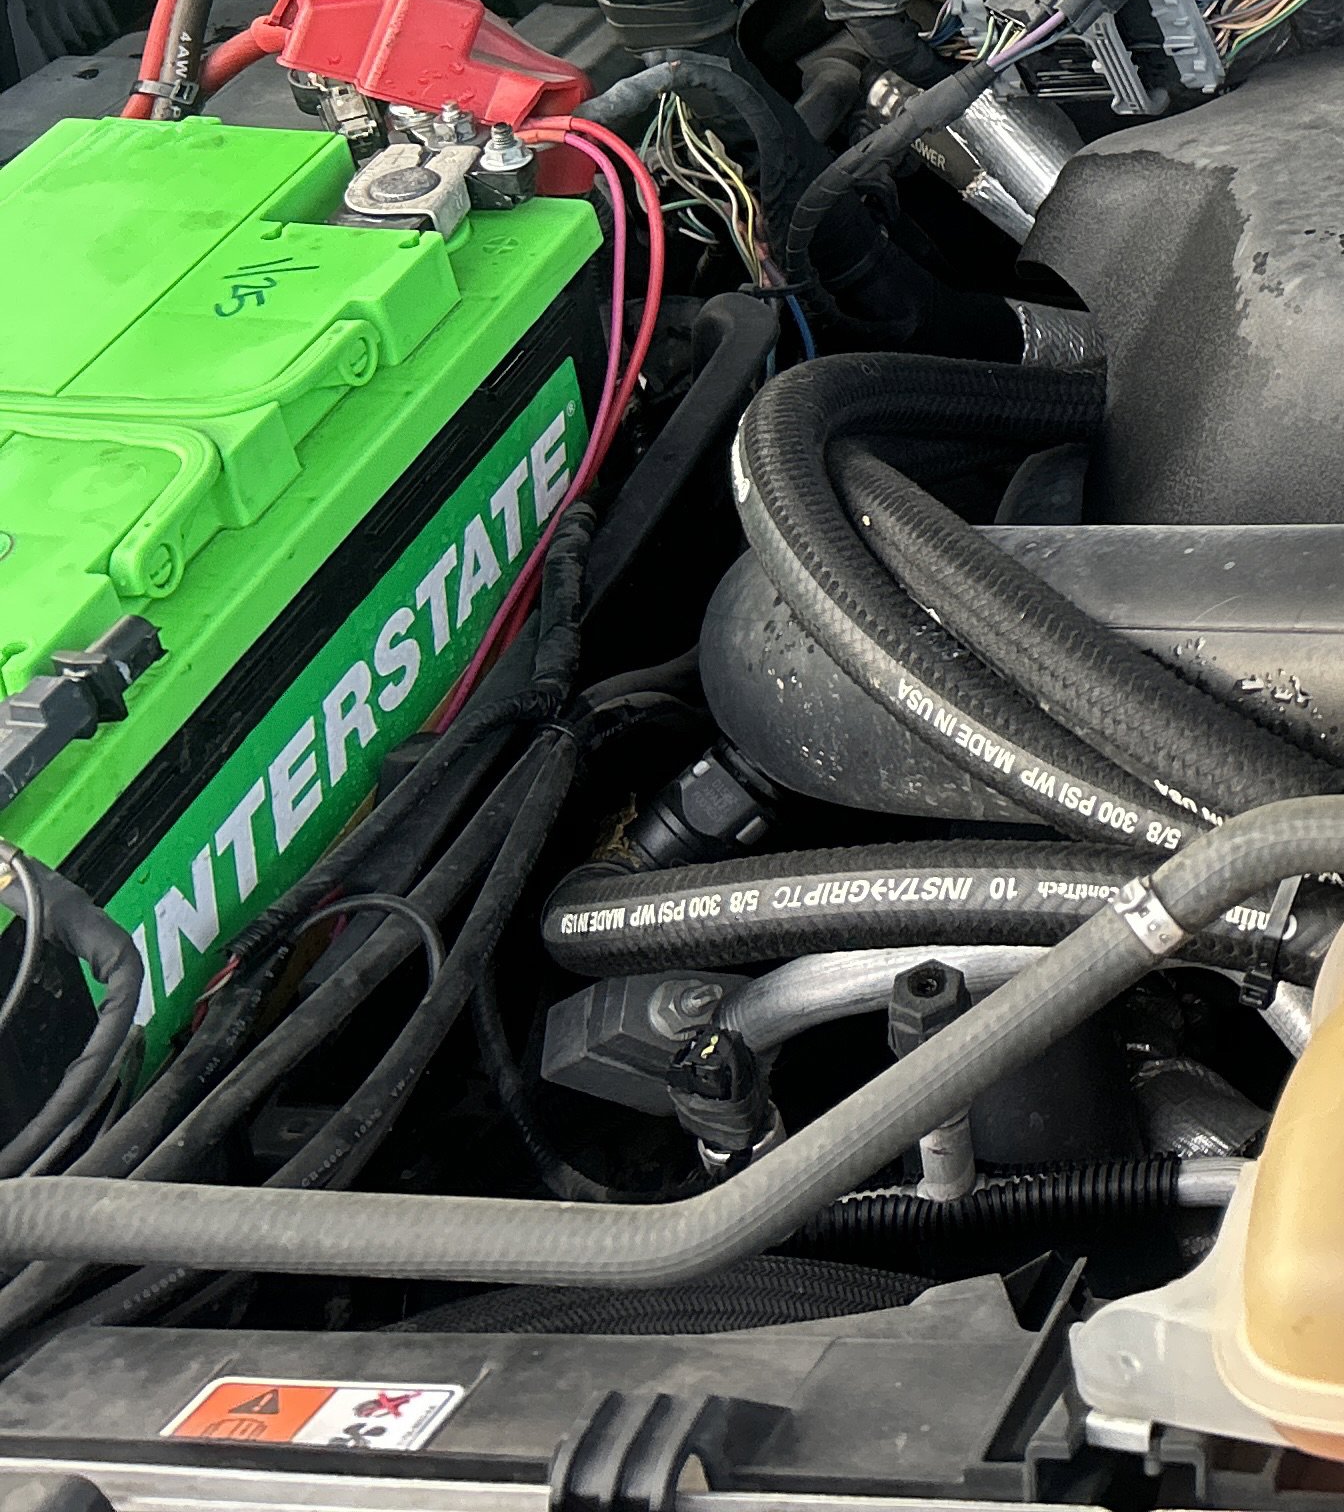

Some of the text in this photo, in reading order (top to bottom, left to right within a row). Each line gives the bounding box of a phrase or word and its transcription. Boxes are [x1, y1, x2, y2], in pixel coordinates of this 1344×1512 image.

[175, 31, 192, 79] 4 AW
[131, 410, 572, 1027] INTERSTATE
[897, 677, 1182, 850] 5/8 300 PSI WP MADE IN USA
[729, 889, 760, 912] 5/8
[989, 876, 1019, 900] 10
[590, 907, 625, 930] MADE
[630, 904, 655, 927] WP
[657, 898, 687, 924] PSI
[689, 894, 722, 919] 300
